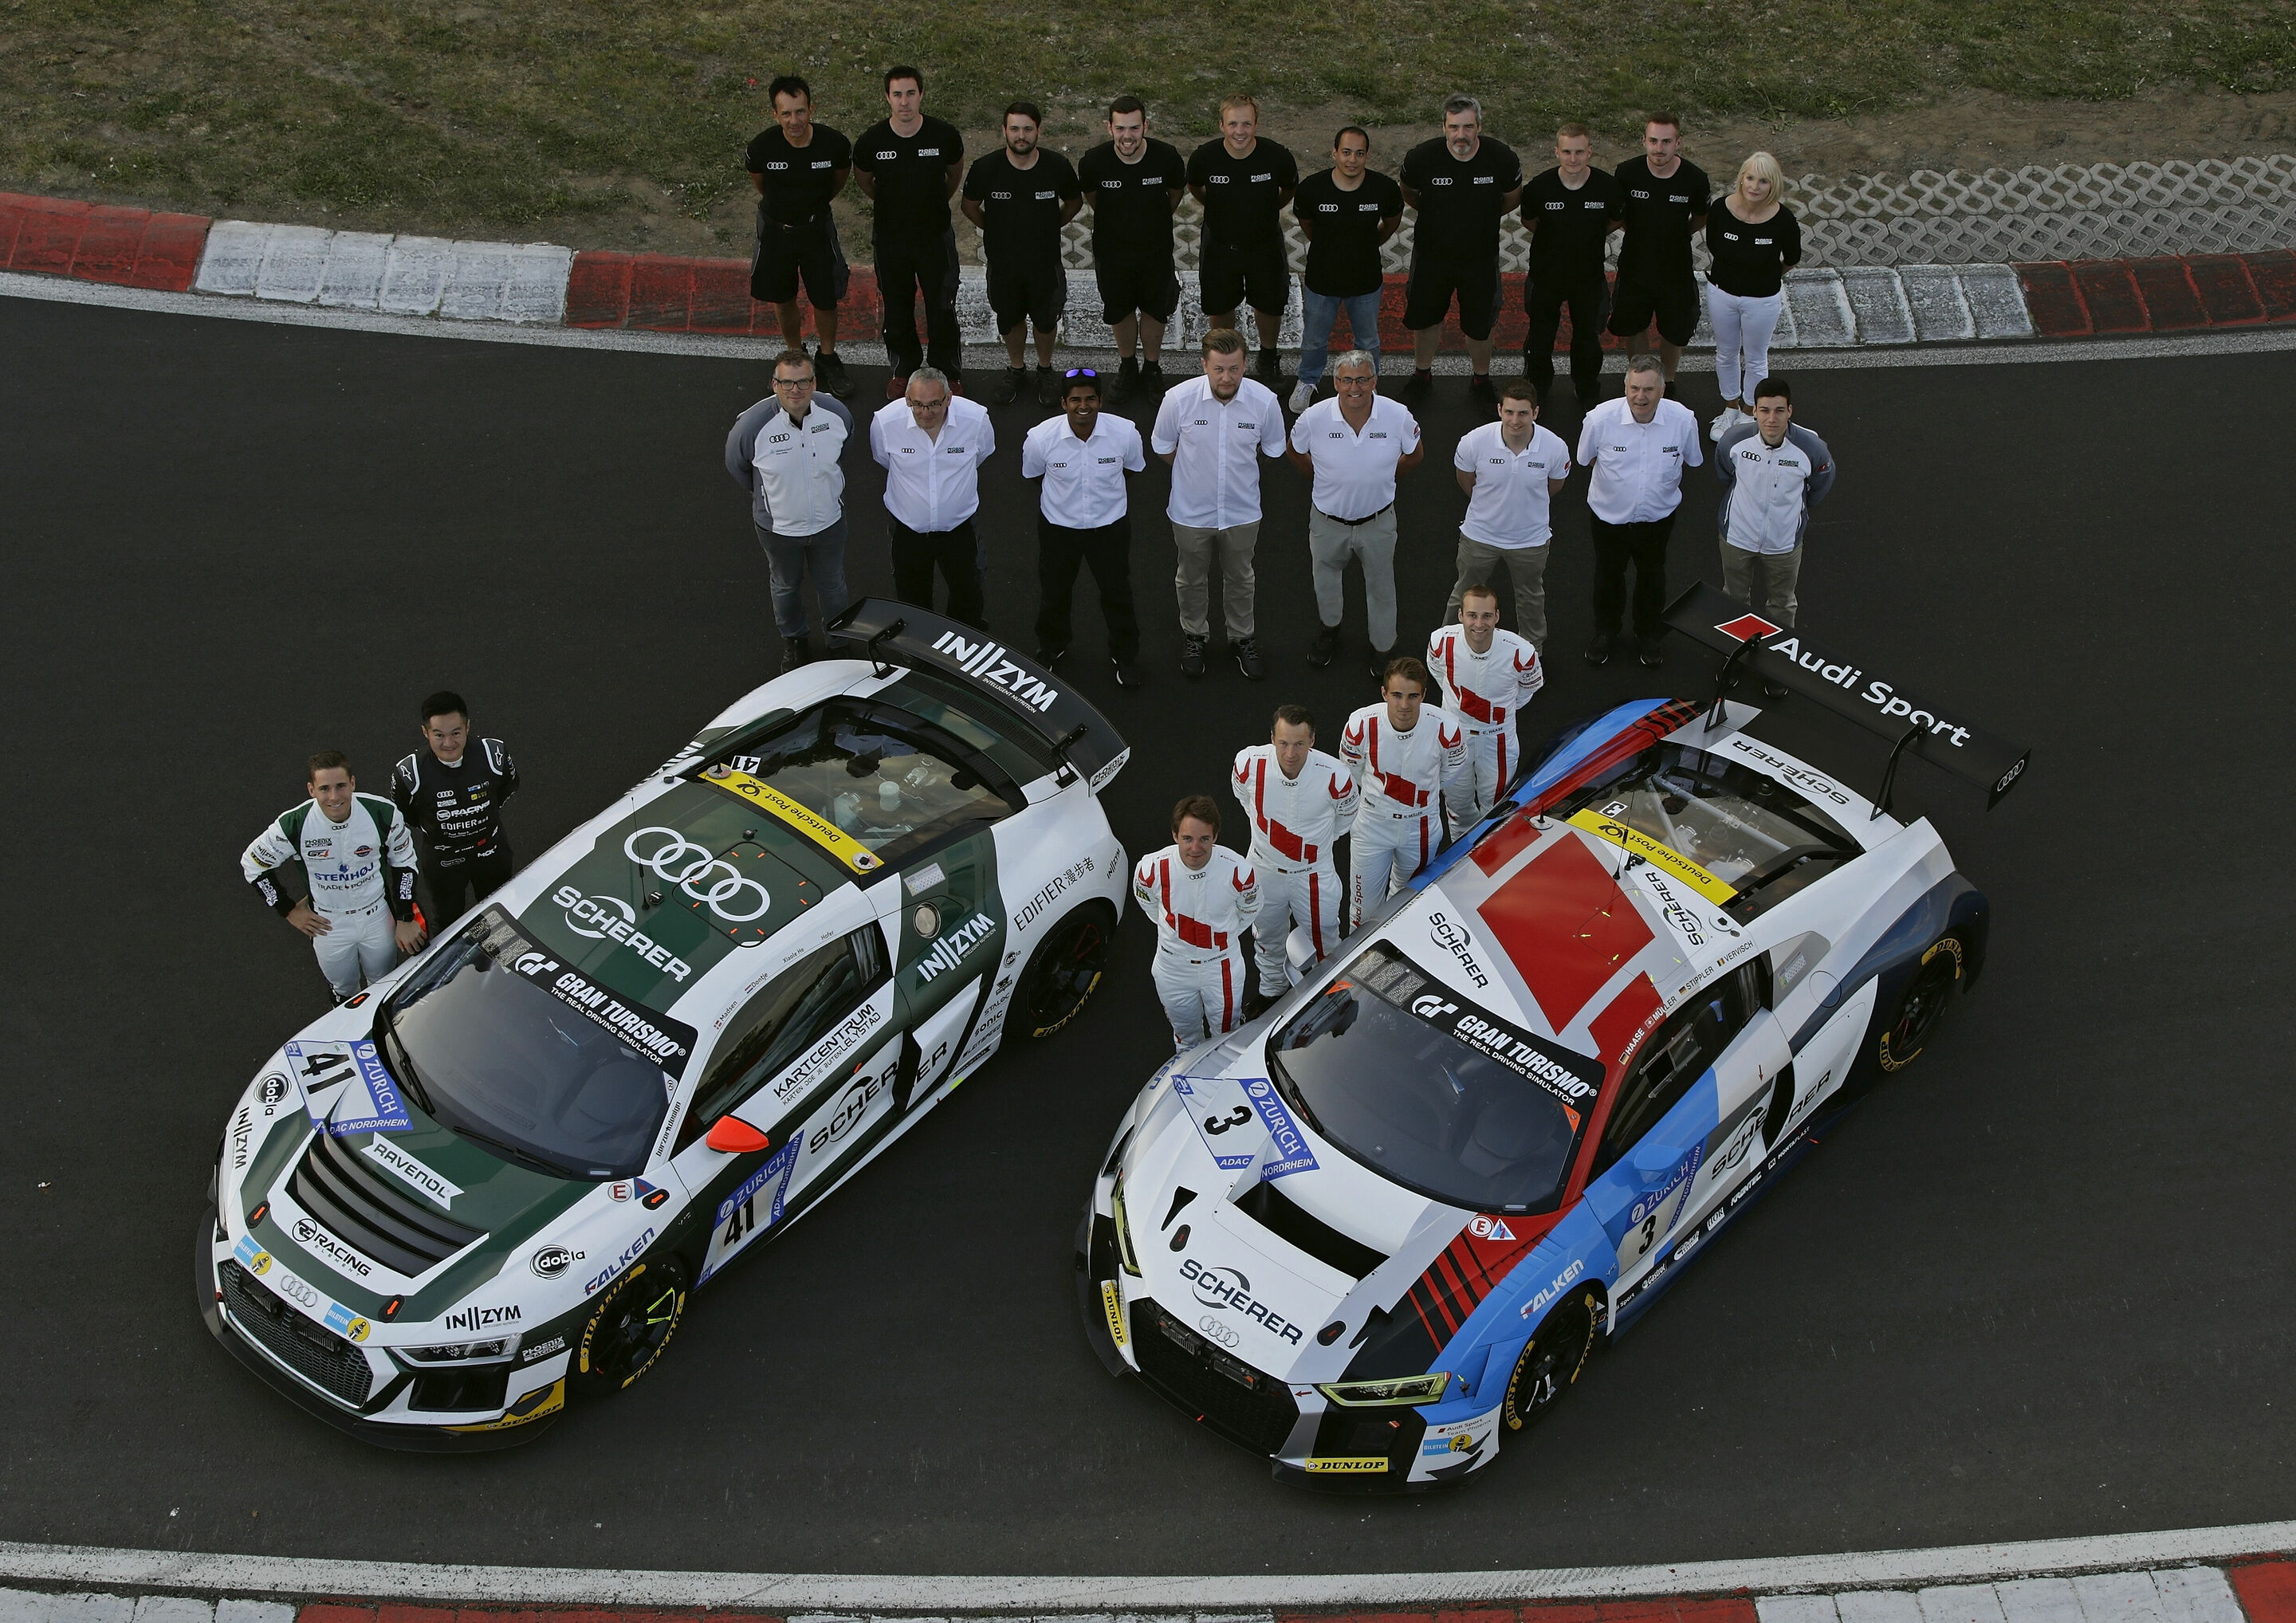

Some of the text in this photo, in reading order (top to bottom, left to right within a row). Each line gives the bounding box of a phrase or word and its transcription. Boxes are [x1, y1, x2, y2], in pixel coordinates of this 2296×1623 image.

[982, 678, 1037, 713] INTELLIGENT NUTRITION
[1768, 638, 1971, 748] Audi Sport
[731, 756, 759, 772] 41
[1732, 741, 1850, 806] SCHERER
[441, 819, 478, 831] EDIFIER
[450, 800, 490, 817] RACING
[765, 793, 841, 843] Deutsche Post
[1602, 802, 1625, 816] 3
[314, 862, 374, 882] STENHØJ
[1629, 834, 1712, 886] Deutsche Post
[317, 873, 375, 891] TRADE POINT
[1355, 874, 1364, 904] Sport
[1013, 876, 1067, 932] EDIFIER
[1645, 871, 1704, 946] SCHERER
[552, 886, 692, 983] SCHERER
[820, 929, 835, 941] Hofer
[1429, 912, 1488, 988] SCHERER
[782, 949, 798, 964] Xiaole
[751, 972, 769, 988] Dontje
[1626, 941, 1753, 1056] HAASE MÜLLER STIPPLER VERVISCH
[555, 973, 679, 1058] GRAN TURISMO
[719, 1000, 737, 1022] Madsen
[984, 992, 1010, 1016] STALOC
[551, 986, 663, 1066] THE REAL DRIVING SIMULATOR
[842, 1012, 881, 1054] LELYSTAD
[773, 1004, 875, 1098] KARTCENTRUM
[1453, 1028, 1575, 1106] THE REAL DRIVING SIMULATOR
[1456, 1015, 1590, 1098] GRAN TURISMO
[301, 1054, 356, 1095] 41
[364, 1059, 399, 1114] ZURICH
[265, 1079, 279, 1116] dobla
[782, 1085, 804, 1106] KARTEN
[348, 1118, 409, 1131] NORDRHEIN
[1203, 1106, 1252, 1135] 3
[1259, 1098, 1301, 1155] ZURICH
[373, 1143, 446, 1199] RAVENOL
[737, 1152, 786, 1204] ZURICH
[773, 1137, 800, 1216] ADAC NORDRHEIN
[1220, 1157, 1314, 1178] ADAC NORDRHEIN
[723, 1195, 755, 1248] 41
[1638, 1214, 1657, 1255] 3
[238, 1241, 256, 1259] BILSTEIN
[313, 1233, 372, 1277] RACING
[314, 1244, 360, 1277] ELEMENT
[540, 1250, 586, 1269] dobla
[583, 1227, 655, 1296] FALKEN
[1179, 1259, 1303, 1346] SCHERER
[1520, 1259, 1585, 1320] FALKEN
[328, 1309, 349, 1326] BILSTEIN
[1107, 1295, 1124, 1343] DUNLOP
[522, 1335, 564, 1356] PHOENIX
[501, 1403, 562, 1427] DUNLOP
[1446, 1418, 1483, 1432] Audi Sport
[1319, 1461, 1385, 1470] DUNLOP
